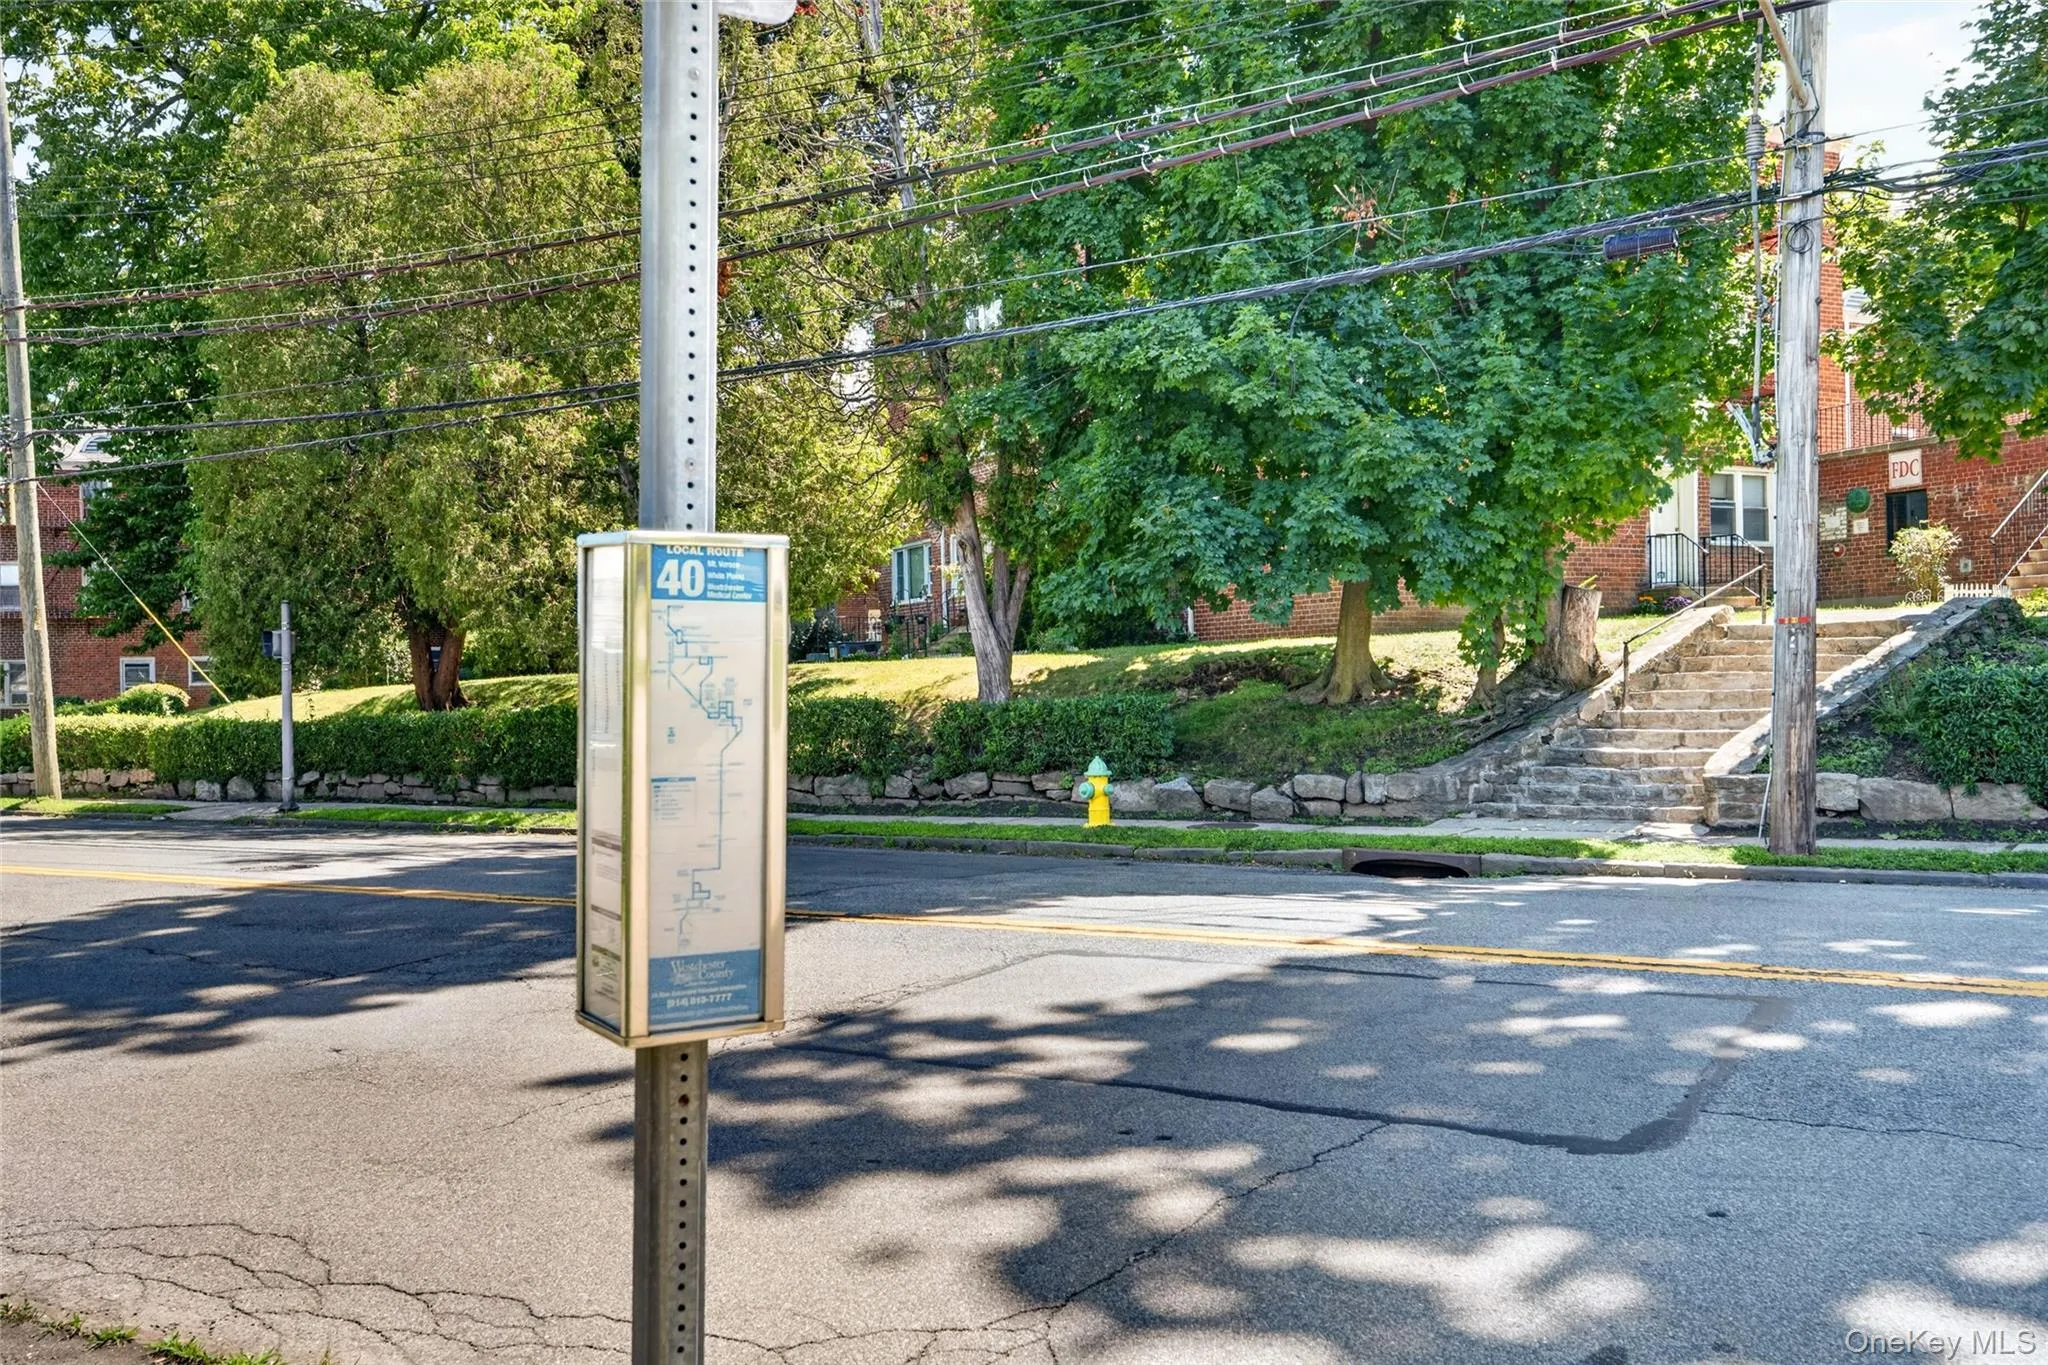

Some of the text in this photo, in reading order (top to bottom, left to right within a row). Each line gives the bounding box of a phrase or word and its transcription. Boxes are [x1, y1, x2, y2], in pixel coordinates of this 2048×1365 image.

[1892, 458, 1920, 479] FDC
[666, 545, 745, 558] LOCAL ROUTE
[656, 559, 705, 597] 40
[699, 968, 736, 980] County
